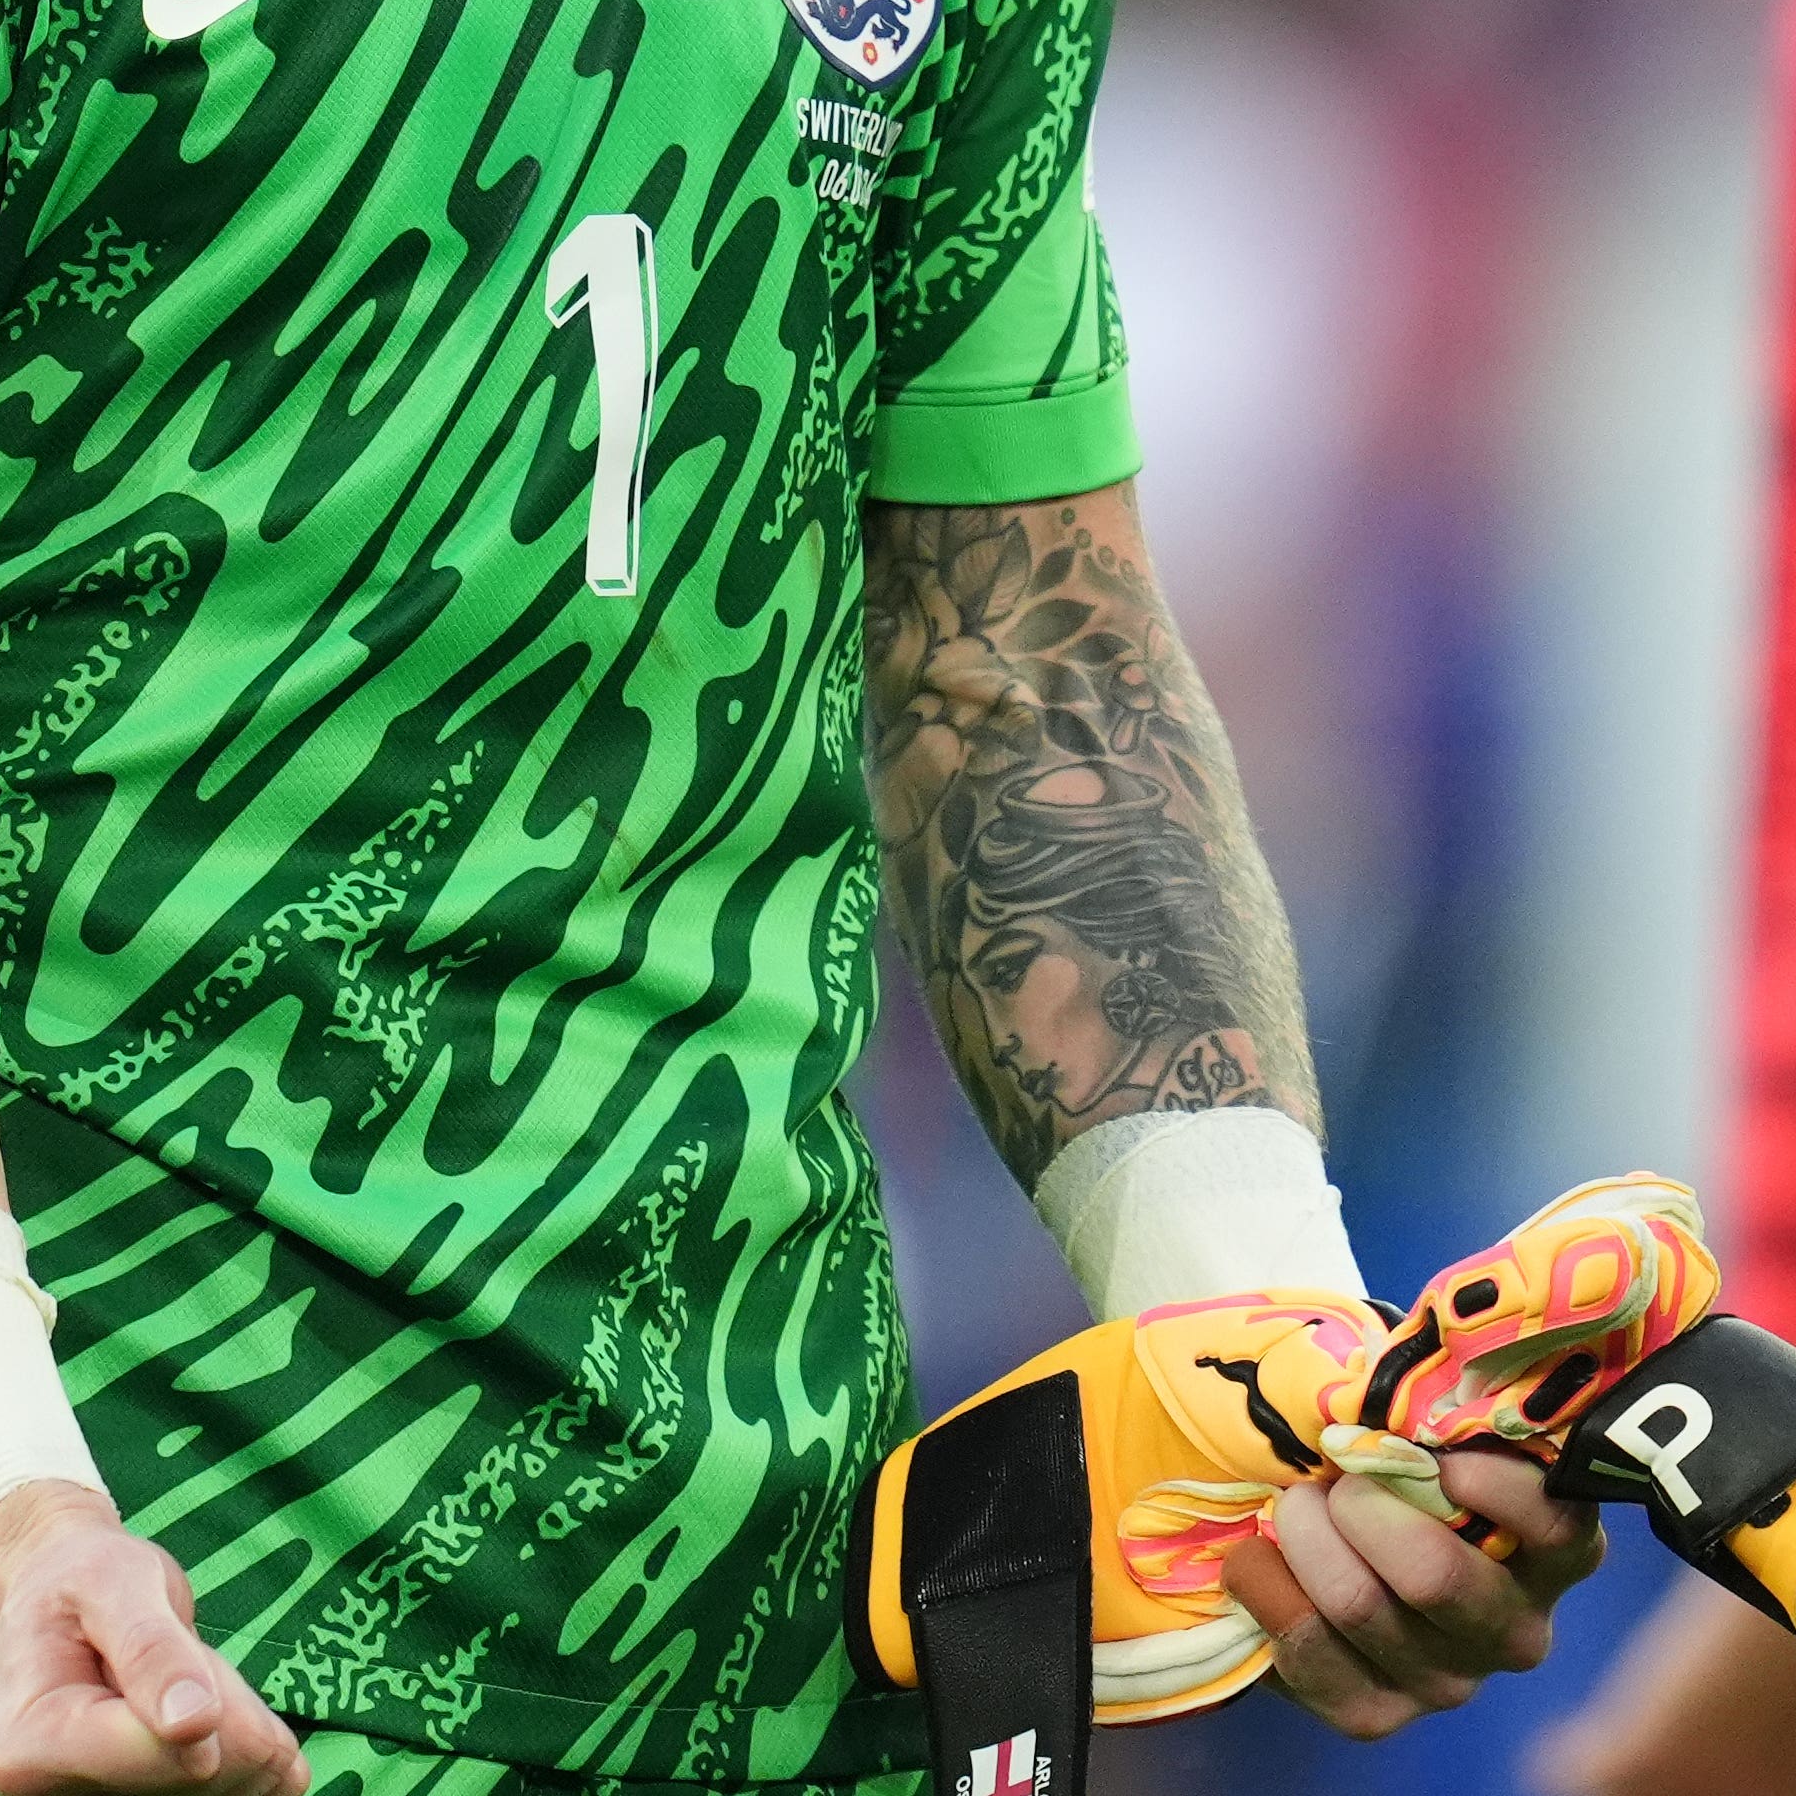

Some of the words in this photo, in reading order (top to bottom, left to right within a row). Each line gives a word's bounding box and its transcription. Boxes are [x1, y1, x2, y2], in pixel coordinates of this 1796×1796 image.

[796, 97, 903, 157] SWITZERL
[819, 159, 878, 210] 06.0
[544, 213, 659, 597] 1
[1604, 1382, 1713, 1517] P
[1034, 1756, 1052, 1796] ARL
